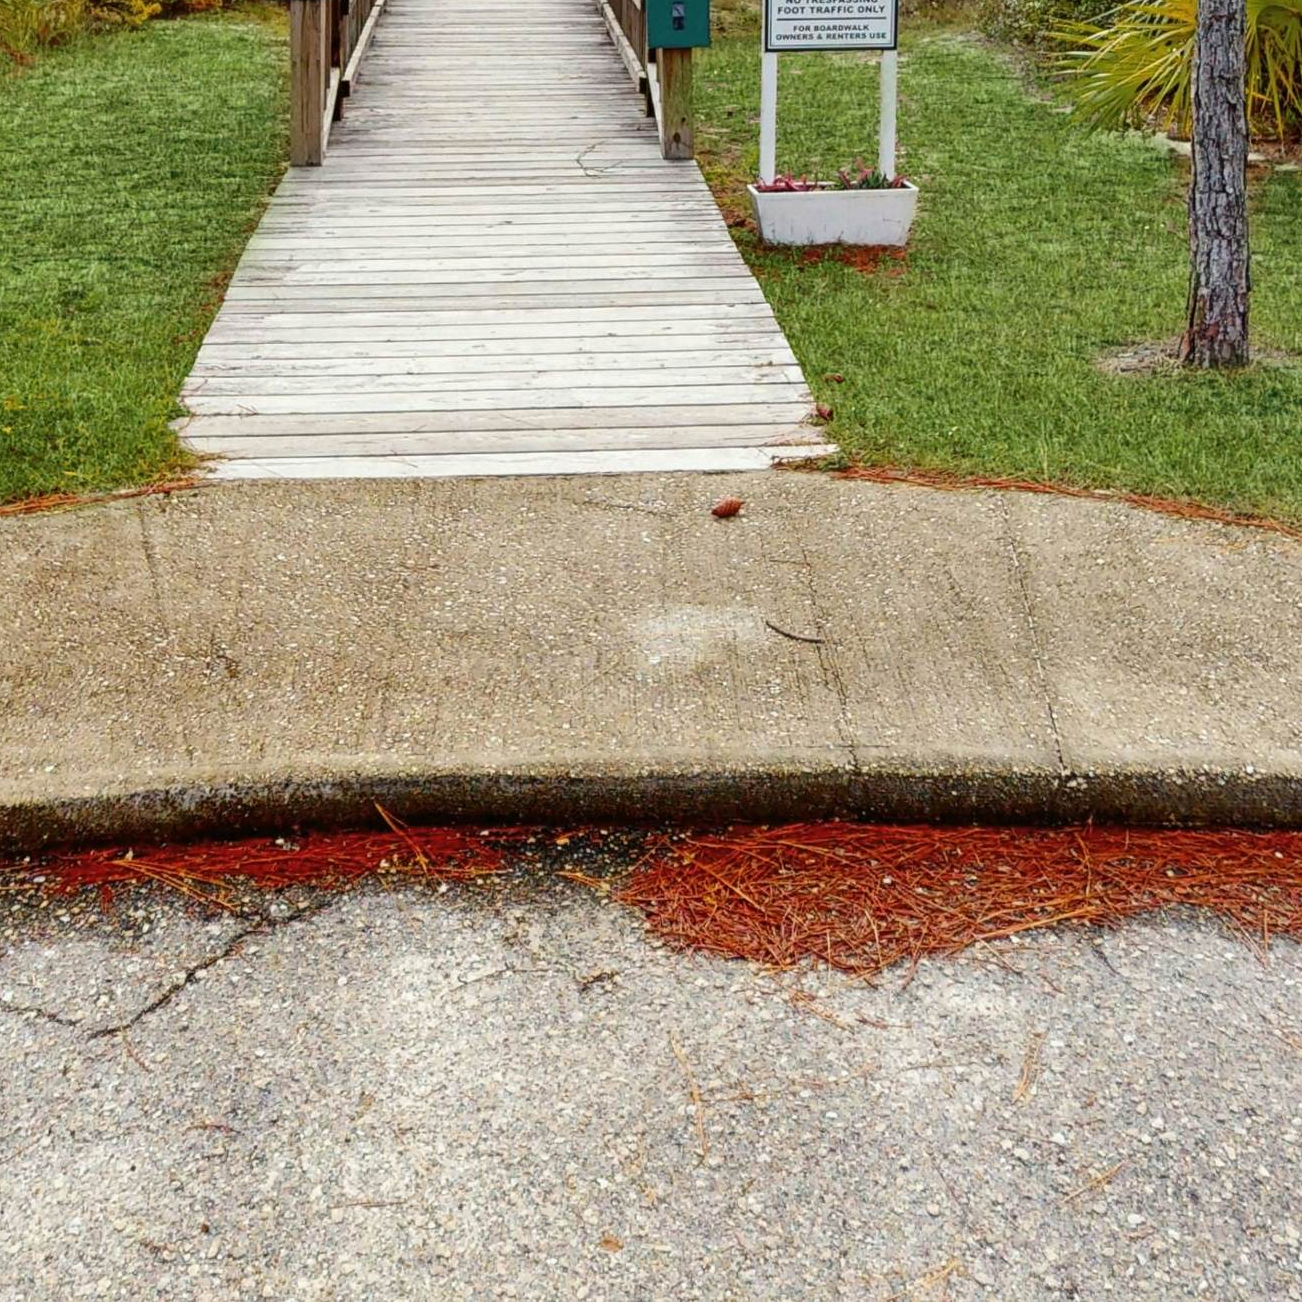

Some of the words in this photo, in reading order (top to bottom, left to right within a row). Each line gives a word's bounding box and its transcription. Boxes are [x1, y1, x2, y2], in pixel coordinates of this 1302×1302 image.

[778, 6, 806, 14] FOOT
[810, 6, 854, 14] TRAFFIC
[858, 5, 886, 14] ONLY
[814, 24, 870, 32] BOARDWALK
[826, 32, 866, 40] RENTERS
